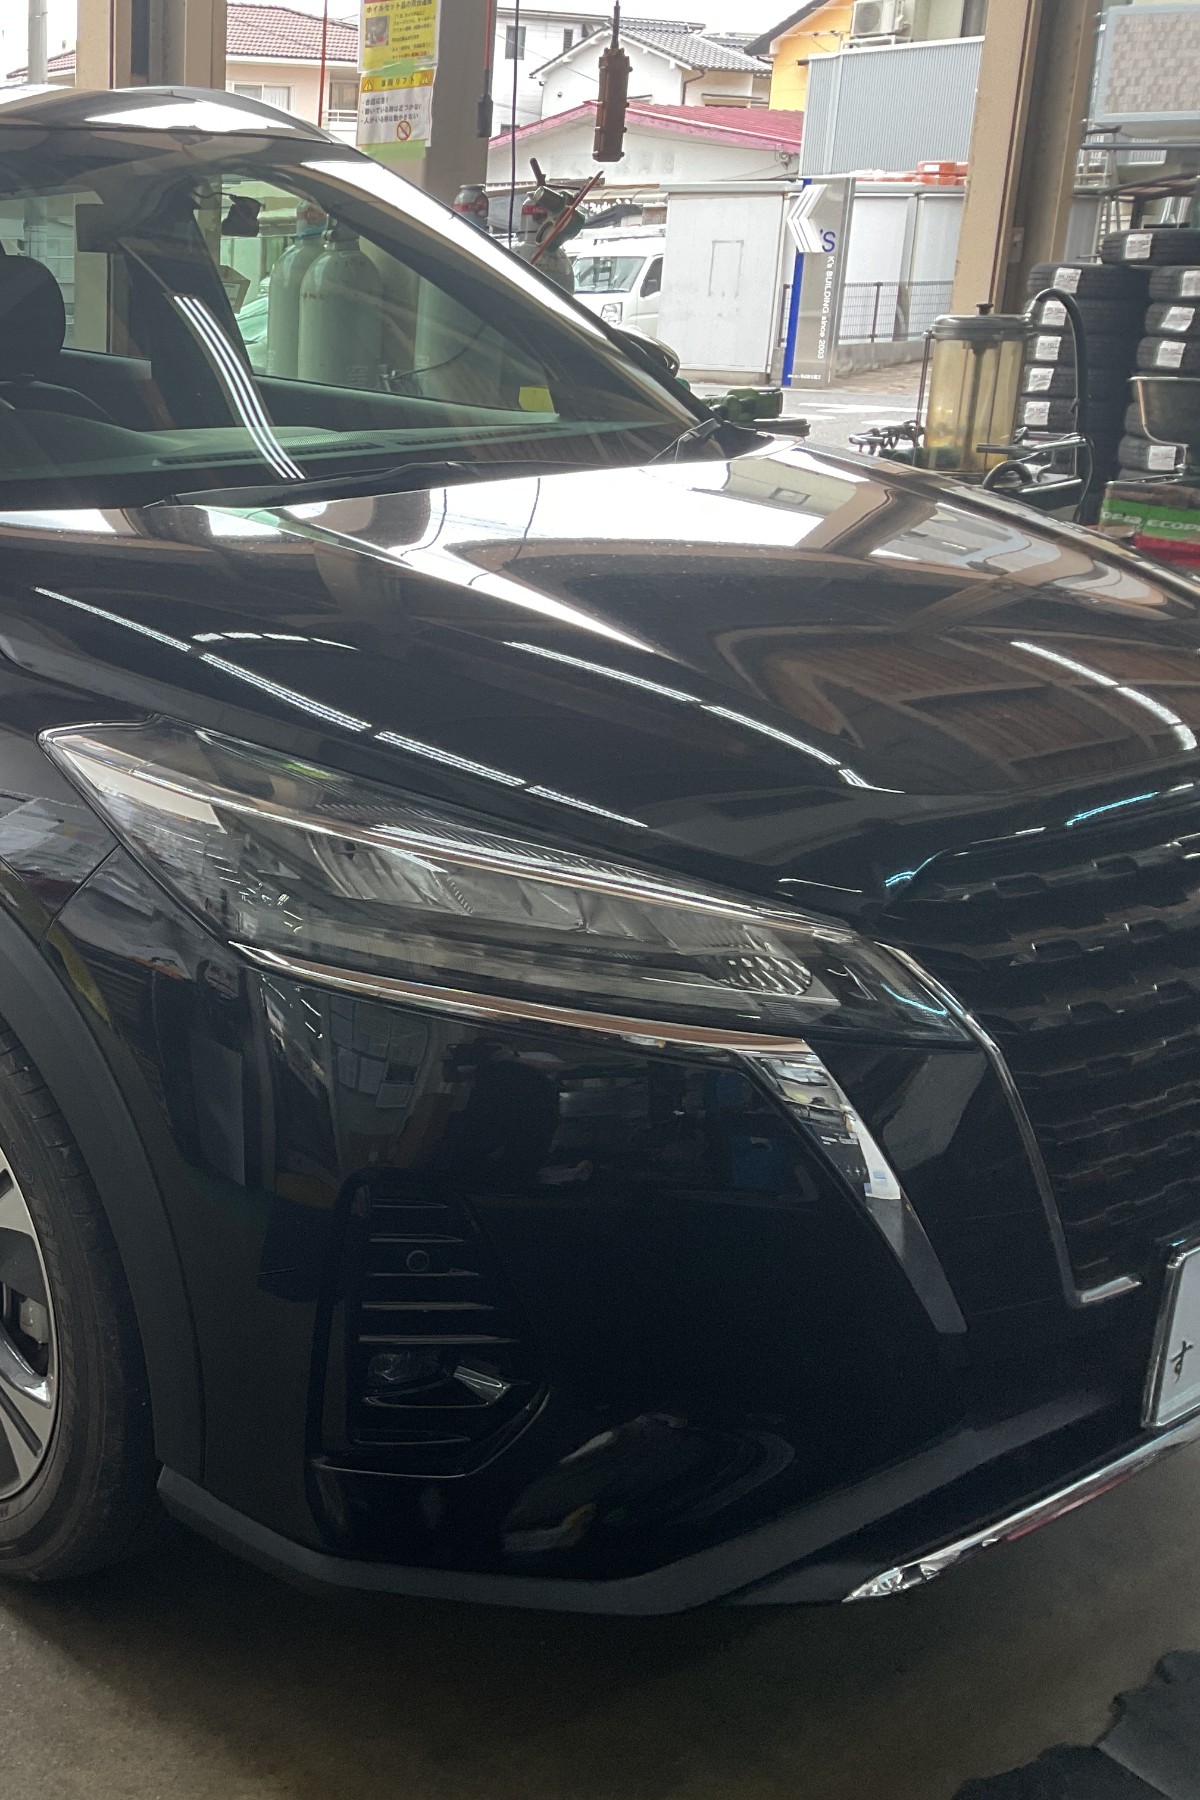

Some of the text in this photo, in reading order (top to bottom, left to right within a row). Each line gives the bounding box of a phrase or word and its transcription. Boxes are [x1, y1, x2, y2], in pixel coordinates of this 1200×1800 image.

[822, 270, 833, 313] BUILDING
[819, 316, 828, 338] since
[817, 339, 825, 359] 2003
[1170, 1340, 1194, 1383] す
